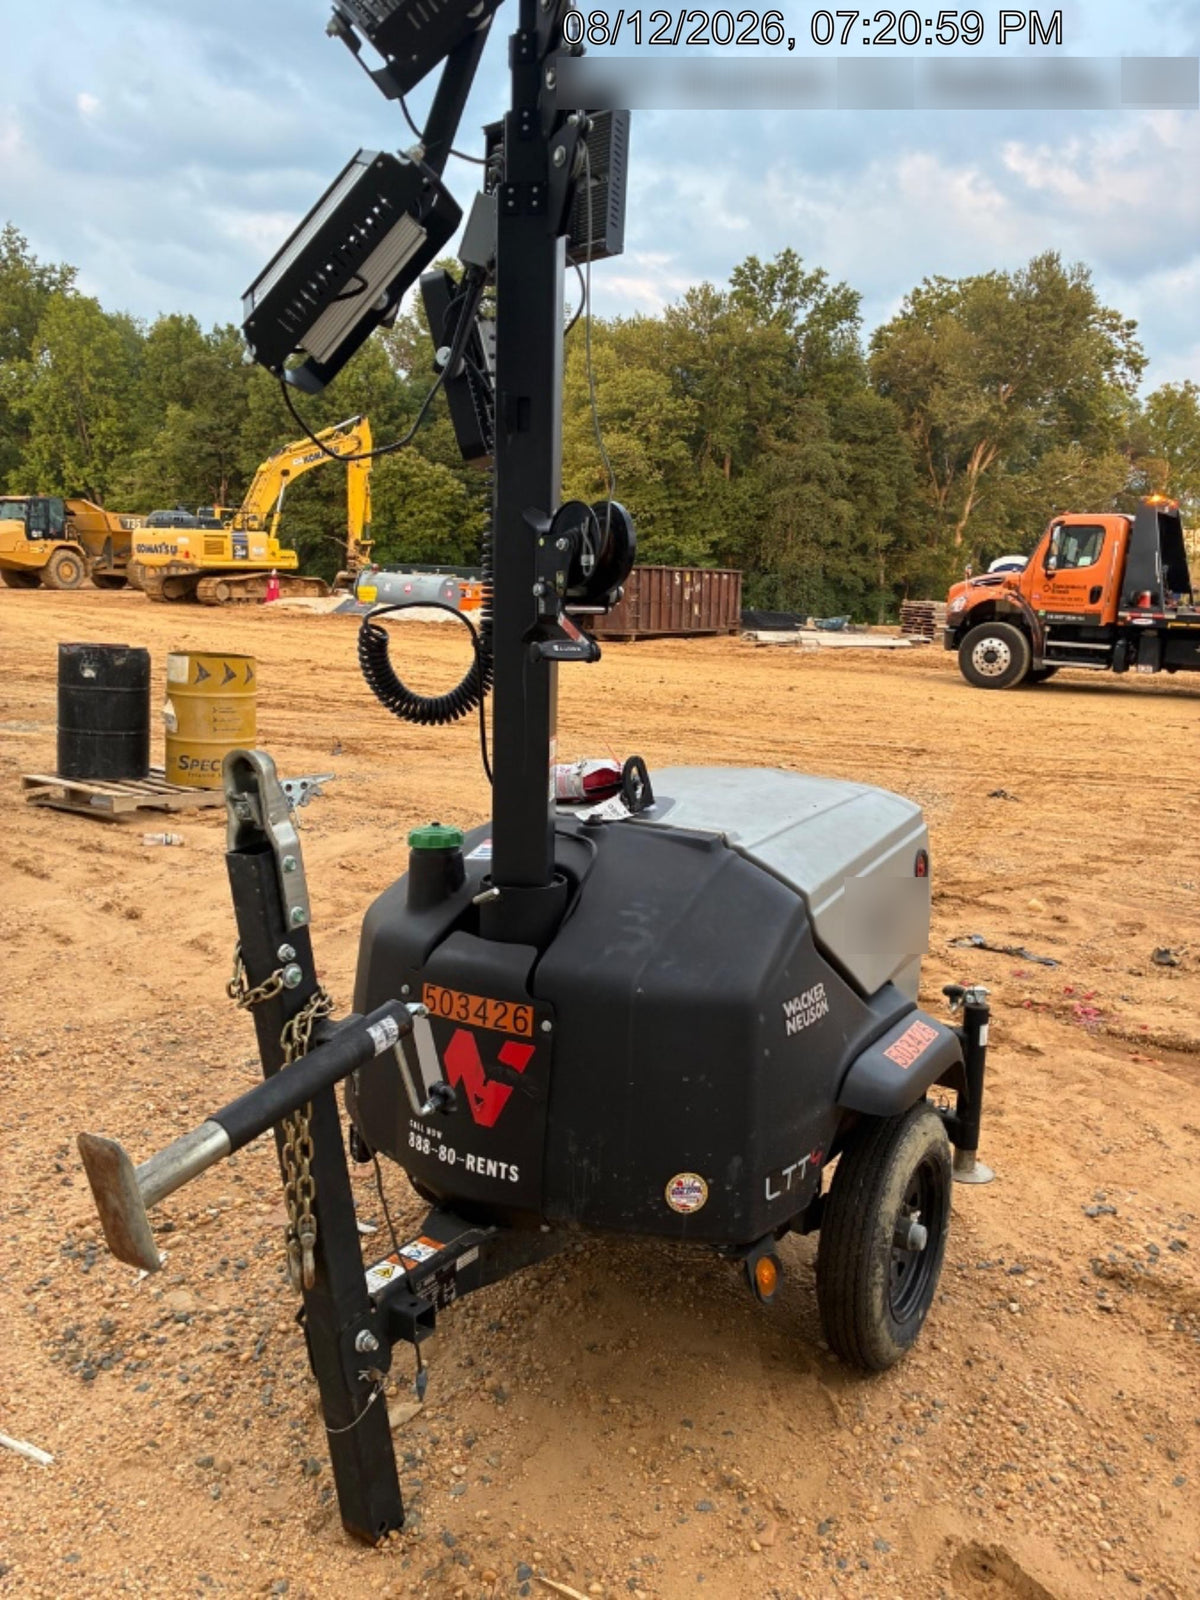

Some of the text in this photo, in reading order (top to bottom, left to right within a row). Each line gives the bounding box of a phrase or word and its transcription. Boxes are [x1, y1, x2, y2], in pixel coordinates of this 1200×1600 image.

[424, 985, 530, 1034] 503426
[782, 982, 827, 1018] WACKER
[785, 997, 829, 1036] NEUSON
[409, 1119, 443, 1139] CALL NOW
[408, 1131, 520, 1183] 888-80-RENTS
